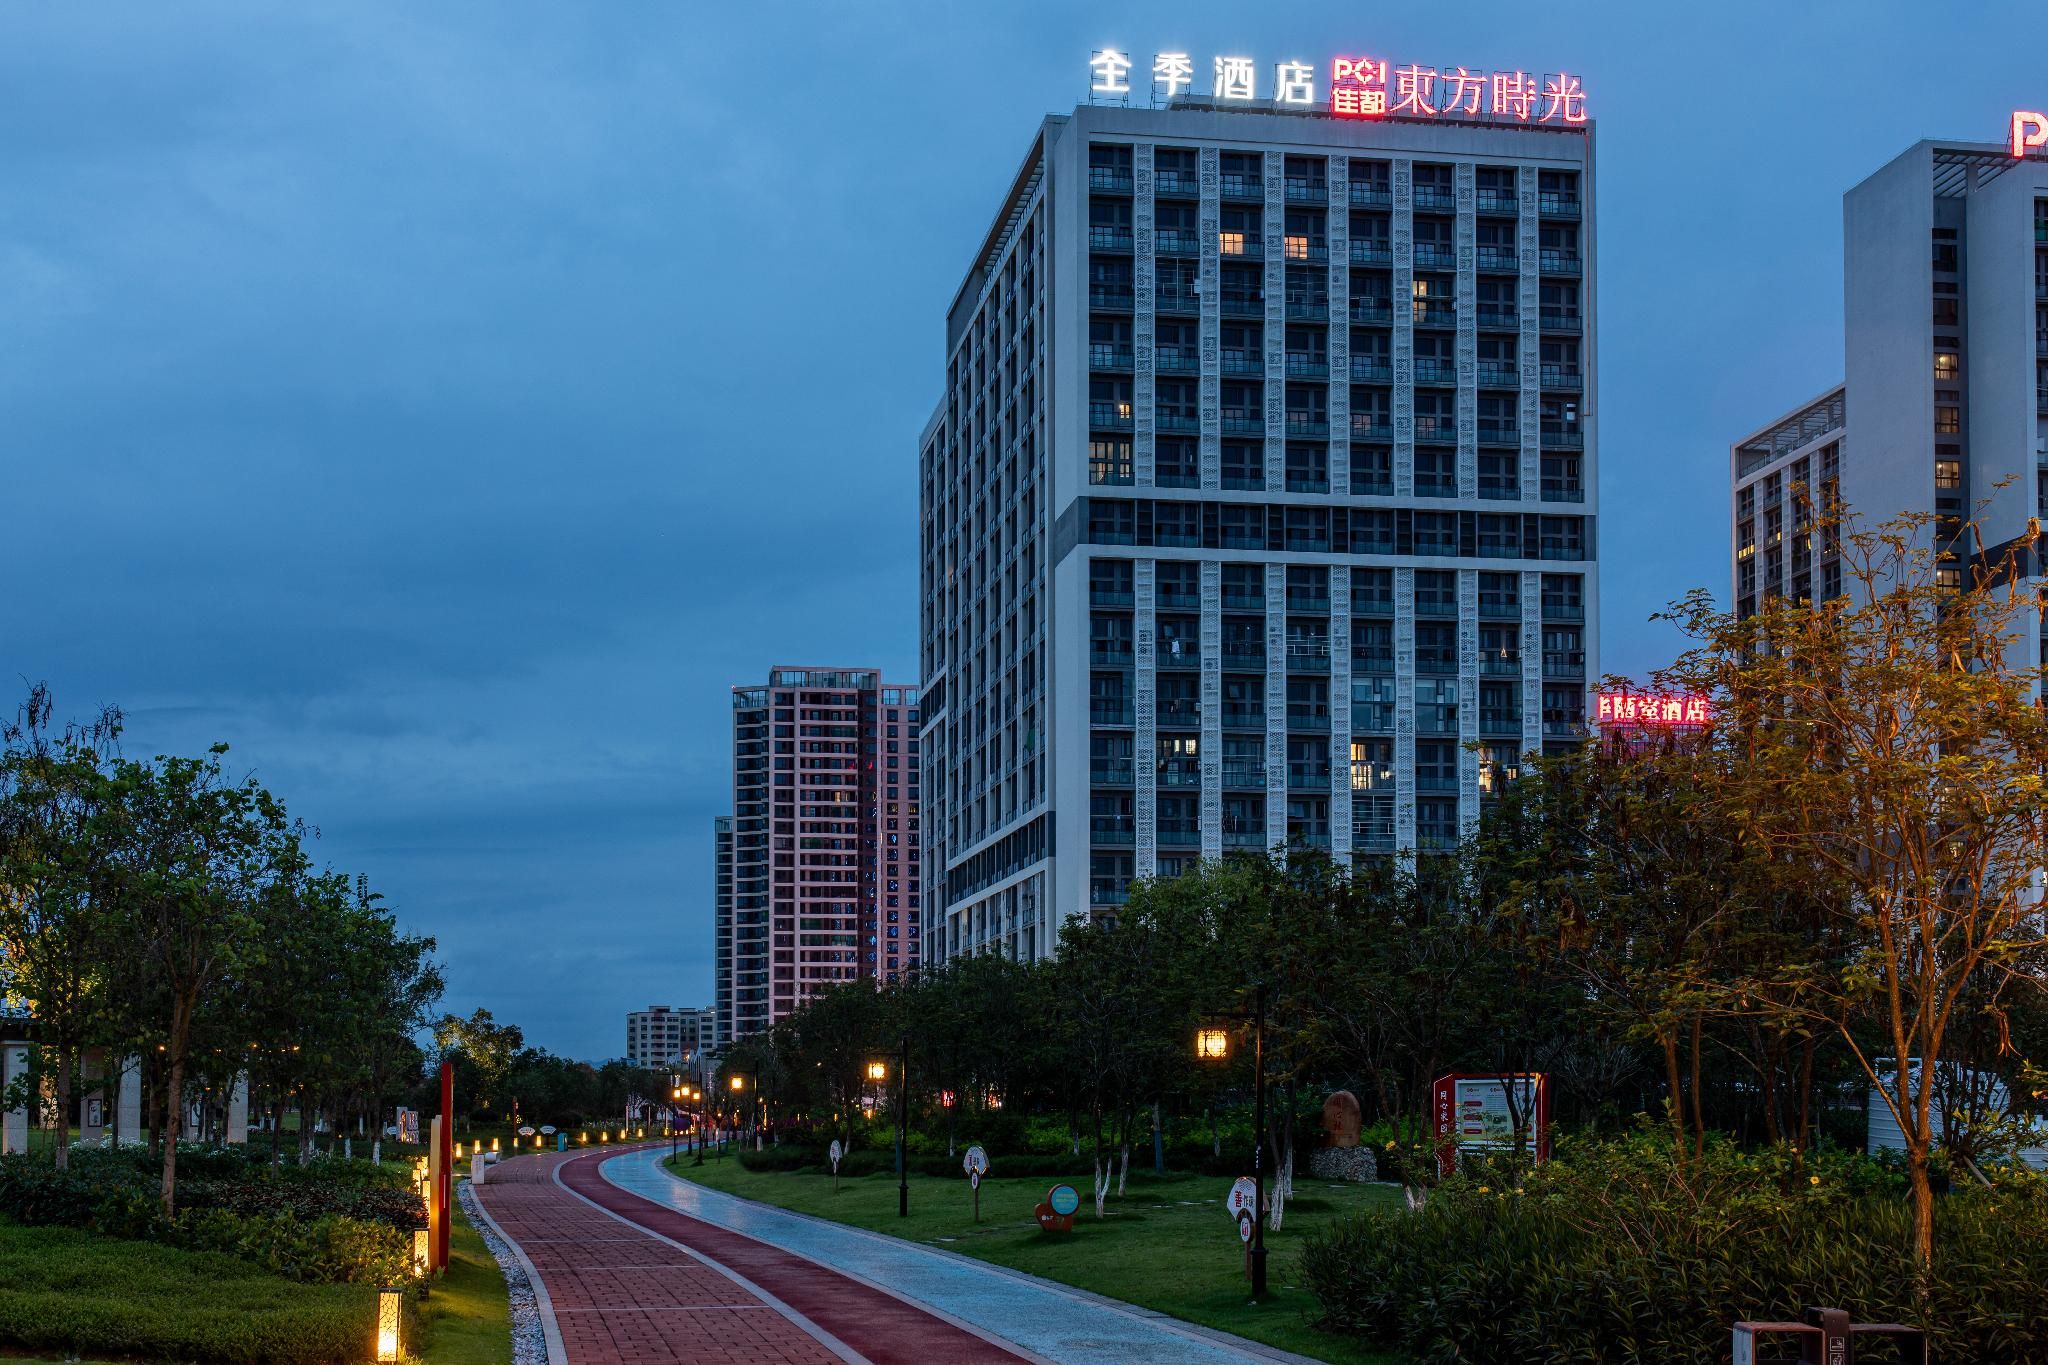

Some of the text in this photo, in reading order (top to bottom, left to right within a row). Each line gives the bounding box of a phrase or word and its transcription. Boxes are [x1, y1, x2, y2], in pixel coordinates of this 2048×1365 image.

[1089, 49, 1315, 103] 全季酒店
[1333, 57, 1386, 86] PCI
[1333, 88, 1386, 116] 佳都
